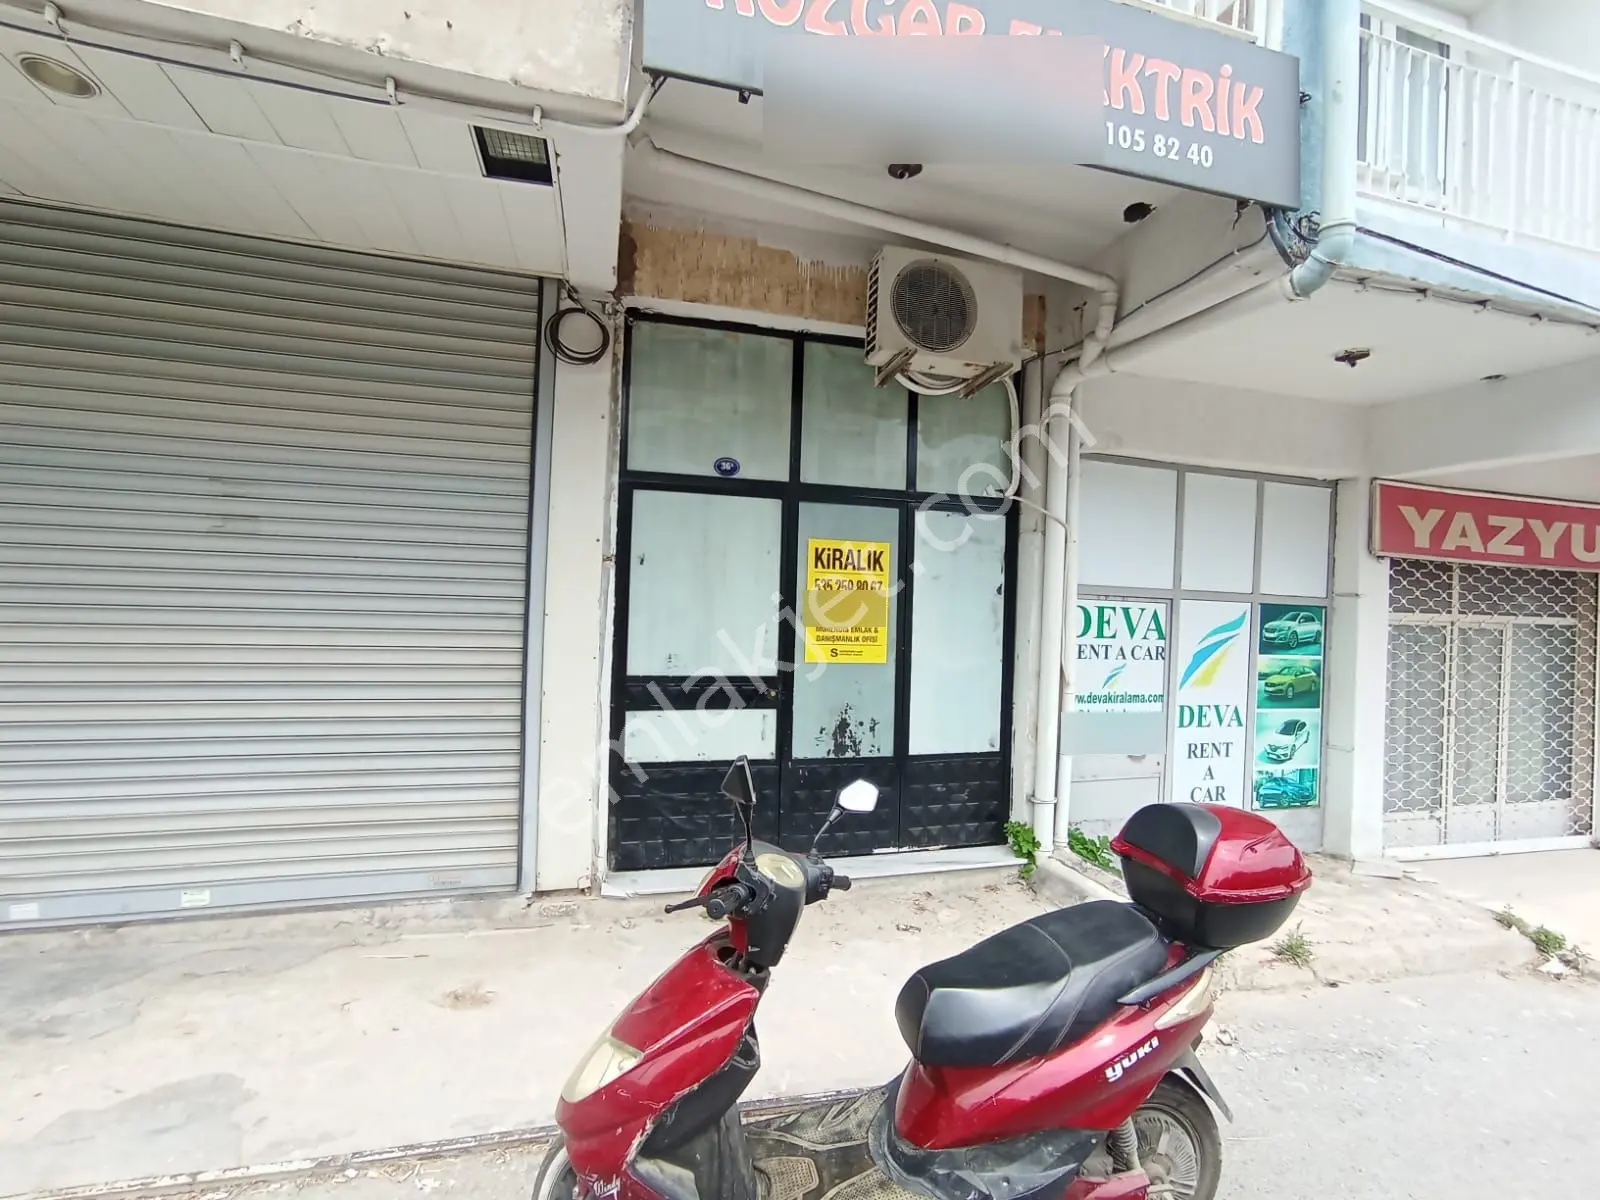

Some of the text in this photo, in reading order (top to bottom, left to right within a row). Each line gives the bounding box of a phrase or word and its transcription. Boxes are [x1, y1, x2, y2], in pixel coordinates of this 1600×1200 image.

[1105, 121, 1214, 168] 105 82 40
[1115, 645, 1127, 660] A
[1131, 645, 1165, 660] CAR
[1177, 704, 1243, 728] DEVA
[1187, 742, 1233, 759] RENT
[1202, 765, 1214, 781] A
[1190, 785, 1226, 802] CAR
